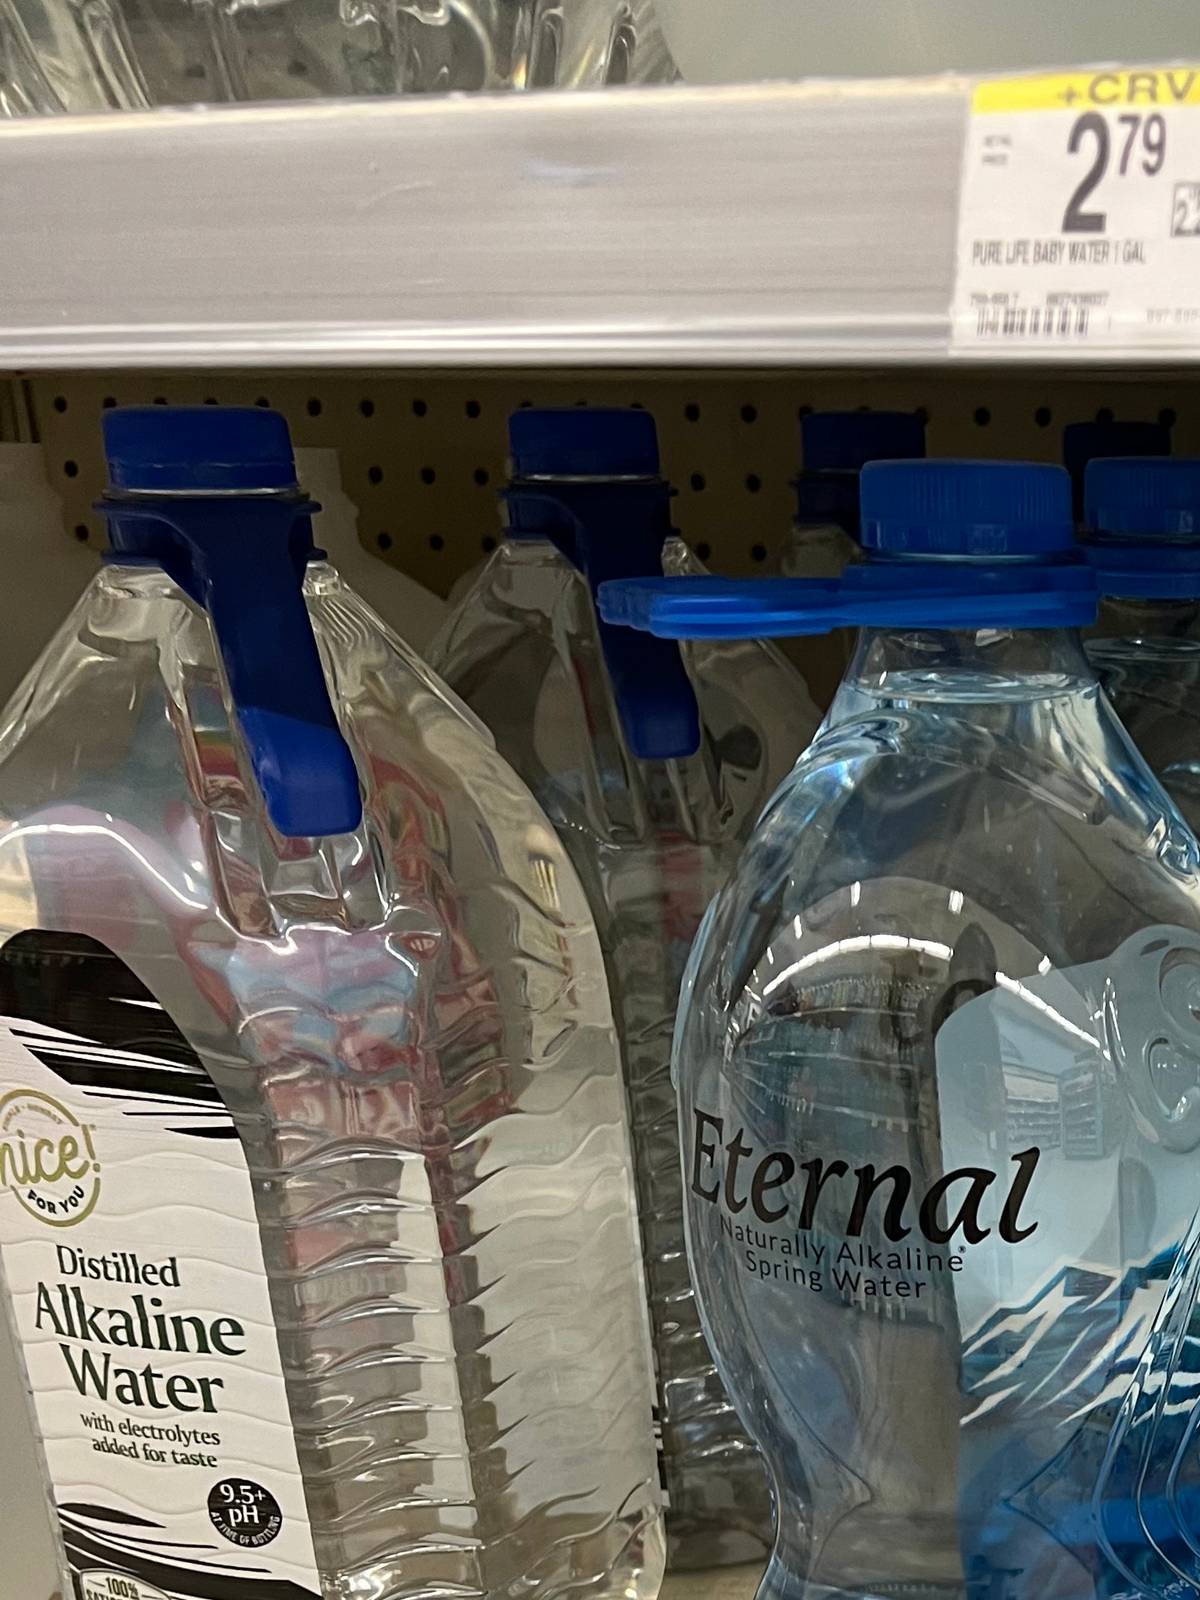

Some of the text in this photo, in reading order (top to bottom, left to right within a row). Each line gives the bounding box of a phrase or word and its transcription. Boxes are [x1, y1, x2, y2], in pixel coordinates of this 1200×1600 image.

[1057, 70, 1198, 104] +CRV
[972, 240, 1002, 266] PURE
[1033, 239, 1064, 265] BABY
[1069, 239, 1110, 265] WATER
[1123, 240, 1146, 265] GAL
[691, 1108, 1041, 1244] Eternal
[28, 1185, 85, 1214] FOR YOU
[720, 1214, 964, 1272] Naturally Alkaline
[56, 1244, 181, 1287] Distilled
[746, 1250, 926, 1298] Spring Water
[35, 1281, 247, 1356] Alkaline
[59, 1342, 224, 1414] Water
[80, 1411, 221, 1448] with electrolytes
[92, 1436, 218, 1468] added for taste
[220, 1484, 267, 1504] 9.5+
[228, 1504, 260, 1527] pH
[105, 1577, 140, 1600] 100%
